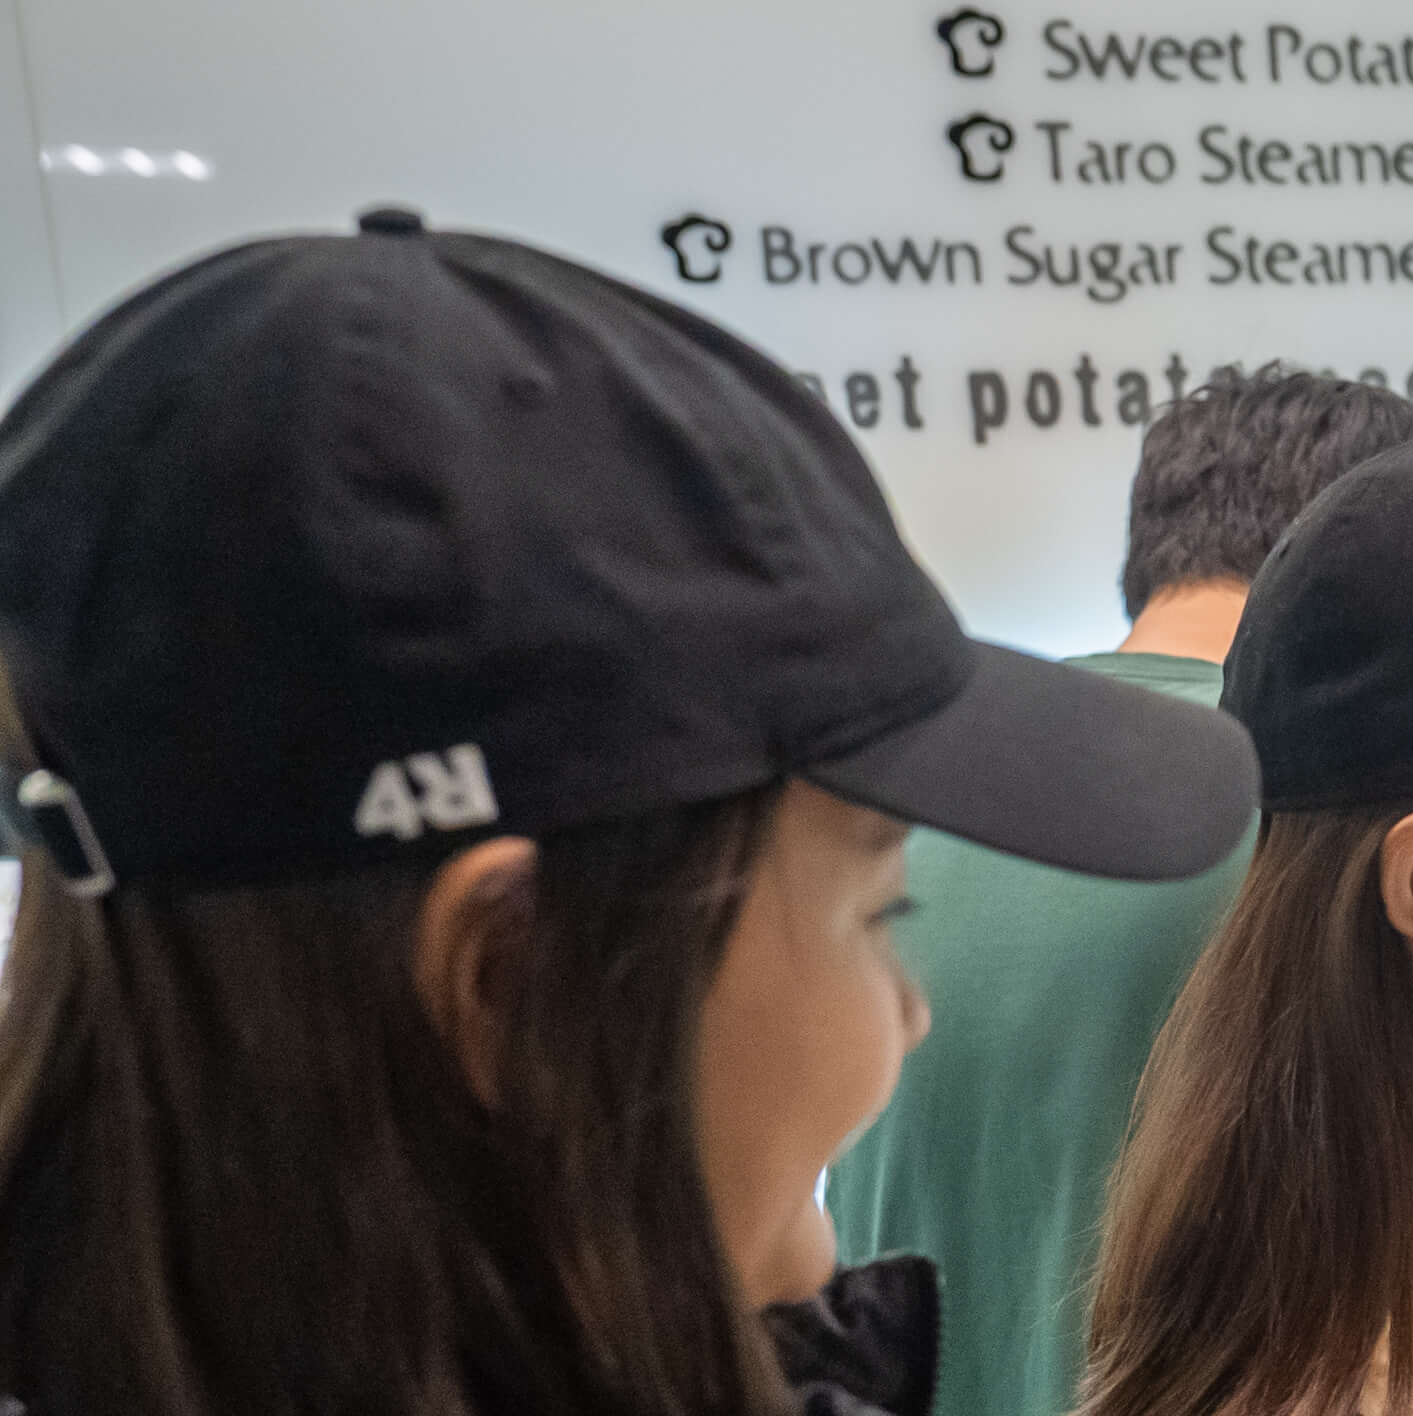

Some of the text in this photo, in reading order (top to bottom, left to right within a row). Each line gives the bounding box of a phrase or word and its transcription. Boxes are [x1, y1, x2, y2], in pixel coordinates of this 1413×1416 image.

[1043, 19, 1247, 84] Sweet
[1034, 121, 1177, 186] Taro
[760, 226, 982, 286] Brown
[1004, 225, 1182, 304] Sugar
